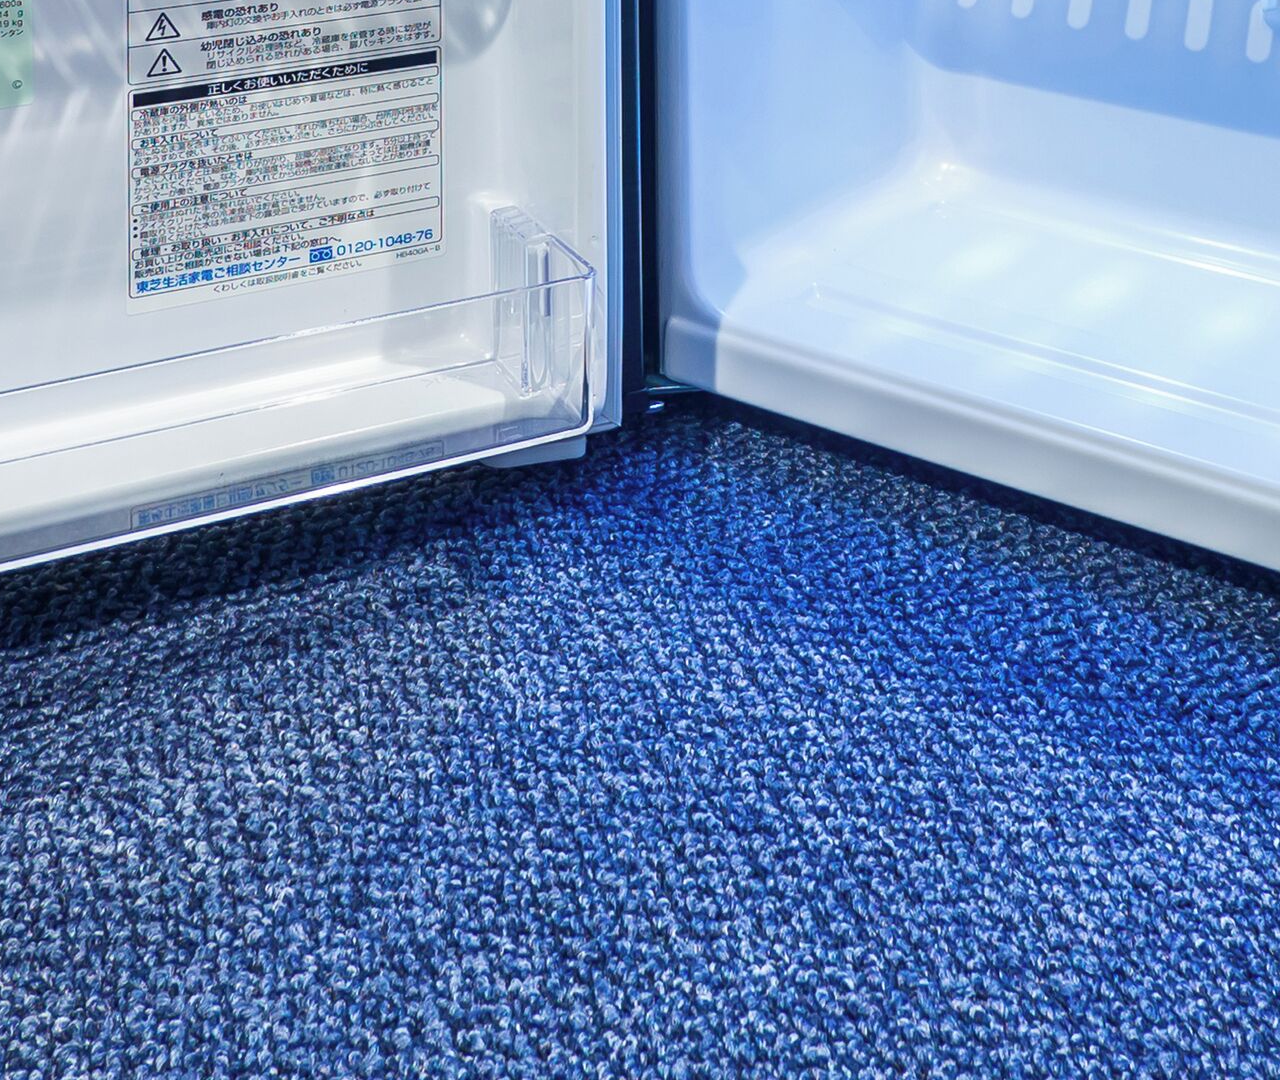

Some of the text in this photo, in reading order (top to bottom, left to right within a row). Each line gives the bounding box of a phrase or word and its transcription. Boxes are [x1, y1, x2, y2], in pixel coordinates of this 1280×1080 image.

[16, 9, 24, 18] g
[200, 1, 278, 21] 感電の恐れあり
[11, 17, 23, 28] kg
[207, 61, 368, 96] 正しくお使いいただくために
[135, 227, 433, 294] 東芝生活家電ご相談センター 0120-1048-76
